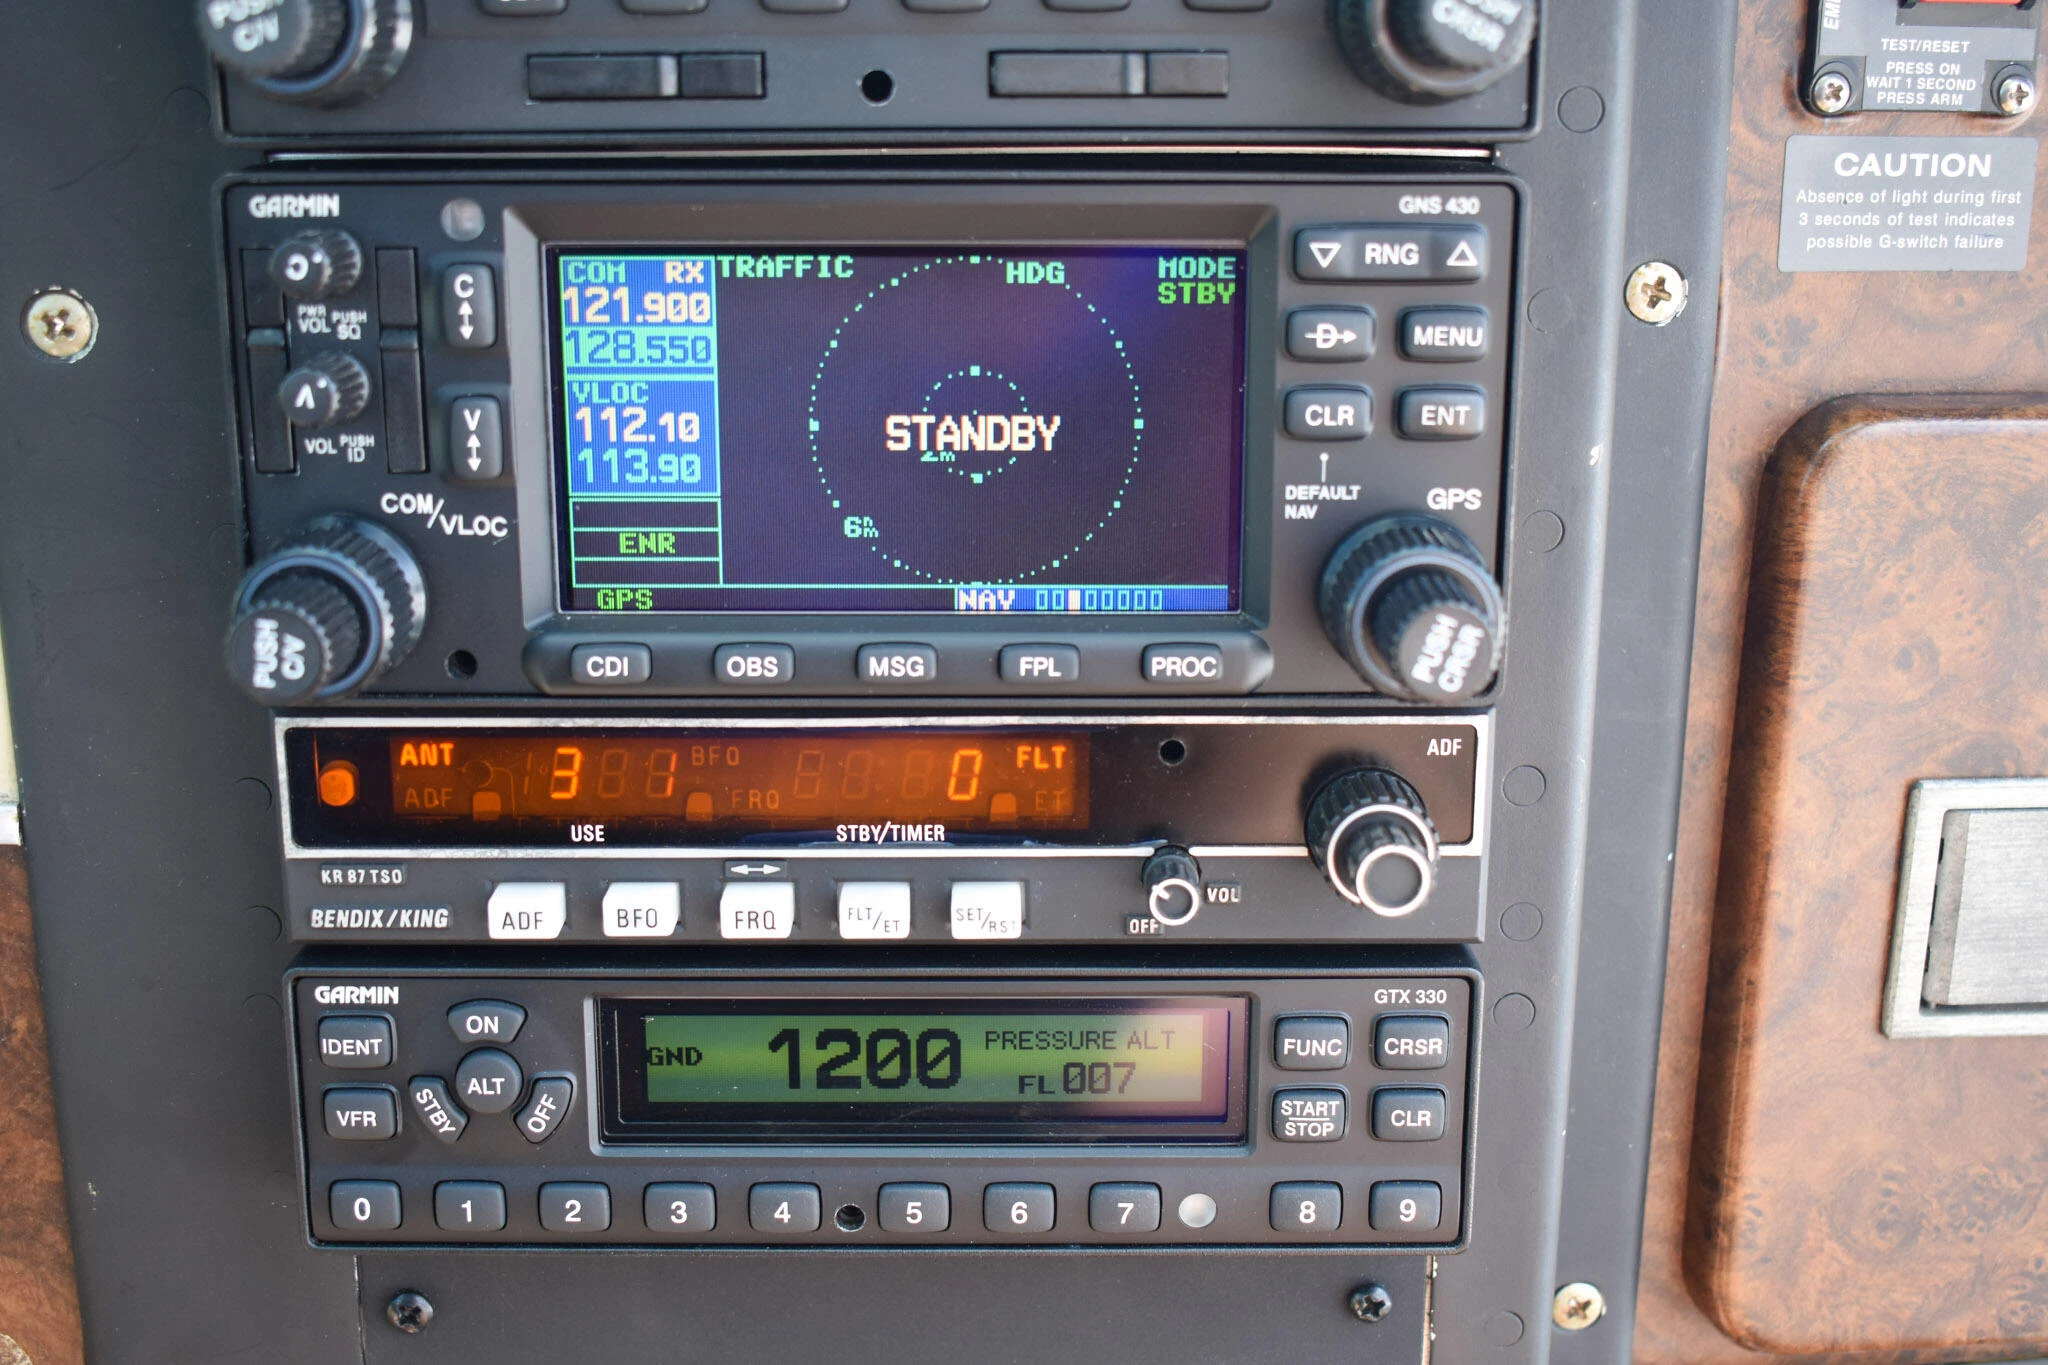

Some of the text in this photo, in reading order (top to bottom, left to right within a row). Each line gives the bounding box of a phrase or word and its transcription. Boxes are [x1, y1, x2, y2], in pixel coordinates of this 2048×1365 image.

[1881, 38, 1971, 54] TEST/RESET
[1886, 62, 1960, 76] PRESS ON
[1866, 76, 1976, 91] WAIT 1 SECOND
[1877, 92, 1963, 106] PRESS ARM
[1834, 152, 1992, 177] CAUTION
[249, 194, 340, 219] GARMIN
[1399, 195, 1480, 215] GNS 430
[1796, 189, 2022, 207] Absence of light during first
[1799, 212, 2015, 226] 3 seconds of test indicates
[1806, 234, 2004, 251] possible G-switch failure
[1364, 242, 1419, 266] RNG
[567, 261, 704, 284] COM RX
[716, 255, 855, 278] TRAFFIC
[1006, 261, 1065, 284] HDG
[1157, 256, 1237, 279] MODE
[454, 273, 474, 299] C
[1157, 282, 1236, 304] STBY
[297, 304, 327, 318] PWR
[562, 286, 711, 323] 121.900
[298, 317, 331, 334] VOL
[331, 310, 367, 324] PUSH
[336, 323, 361, 341] SQ
[1413, 325, 1484, 347] MENU
[565, 329, 711, 364] 128.550
[572, 382, 649, 404] VLOC
[463, 408, 482, 432] V
[575, 406, 700, 443] 112.10
[1304, 405, 1355, 426] CLR
[1420, 405, 1472, 426] ENT
[340, 434, 374, 448] PUSH
[885, 415, 1061, 452] STANDBY
[304, 438, 338, 455] VOL
[347, 448, 366, 463] ID
[577, 448, 702, 484] 113.90
[1284, 485, 1361, 501] DEFAULT
[1426, 487, 1483, 511] GPS
[1284, 504, 1318, 519] NAV
[619, 532, 676, 554] ENR
[596, 588, 654, 611] GPS
[958, 589, 1016, 611] NAV
[586, 656, 629, 678] CDI
[726, 656, 779, 678] OBS
[869, 656, 925, 678] MSG
[1019, 656, 1062, 678] FPL
[1151, 656, 1218, 678] PROC
[400, 742, 455, 767] ANT
[1016, 745, 1067, 769] FLT
[1426, 738, 1463, 757] ADF
[404, 787, 453, 809] ADF
[570, 824, 605, 843] USE
[836, 820, 946, 845] STBY/TIMER
[321, 869, 403, 884] KR 87 TSO
[1207, 887, 1240, 903] VOL
[311, 908, 449, 929] BENDIX/KING
[501, 911, 544, 931] ADF
[617, 908, 658, 929] BFO
[735, 910, 777, 932] FRQ
[1129, 917, 1159, 934] OFF
[314, 985, 399, 1005] GARMIN
[1374, 989, 1447, 1004] GTX 330
[465, 1015, 499, 1034] ON
[322, 1038, 383, 1056] IDENT
[985, 1030, 1176, 1050] PRESSURE ALT
[1283, 1038, 1343, 1057] FUNC
[1384, 1037, 1443, 1056] CRSR
[649, 1046, 703, 1067] GND
[768, 1029, 961, 1090] 1200
[467, 1077, 505, 1095] ALT
[1018, 1061, 1137, 1095] FL 007
[336, 1110, 377, 1127] VFR
[415, 1088, 456, 1135] STBY
[527, 1093, 557, 1134] OFF
[1280, 1100, 1340, 1117] START
[1390, 1110, 1431, 1127] CLR
[1285, 1122, 1335, 1137] STOP
[354, 1197, 371, 1221] 0
[461, 1200, 472, 1222] 1
[564, 1200, 582, 1223] 2
[670, 1202, 687, 1225] 3
[773, 1202, 792, 1225] 4
[905, 1202, 923, 1225] 5
[1010, 1202, 1028, 1225] 6
[1117, 1203, 1134, 1225] 7
[1299, 1200, 1317, 1225] 8
[1399, 1199, 1417, 1223] 9
